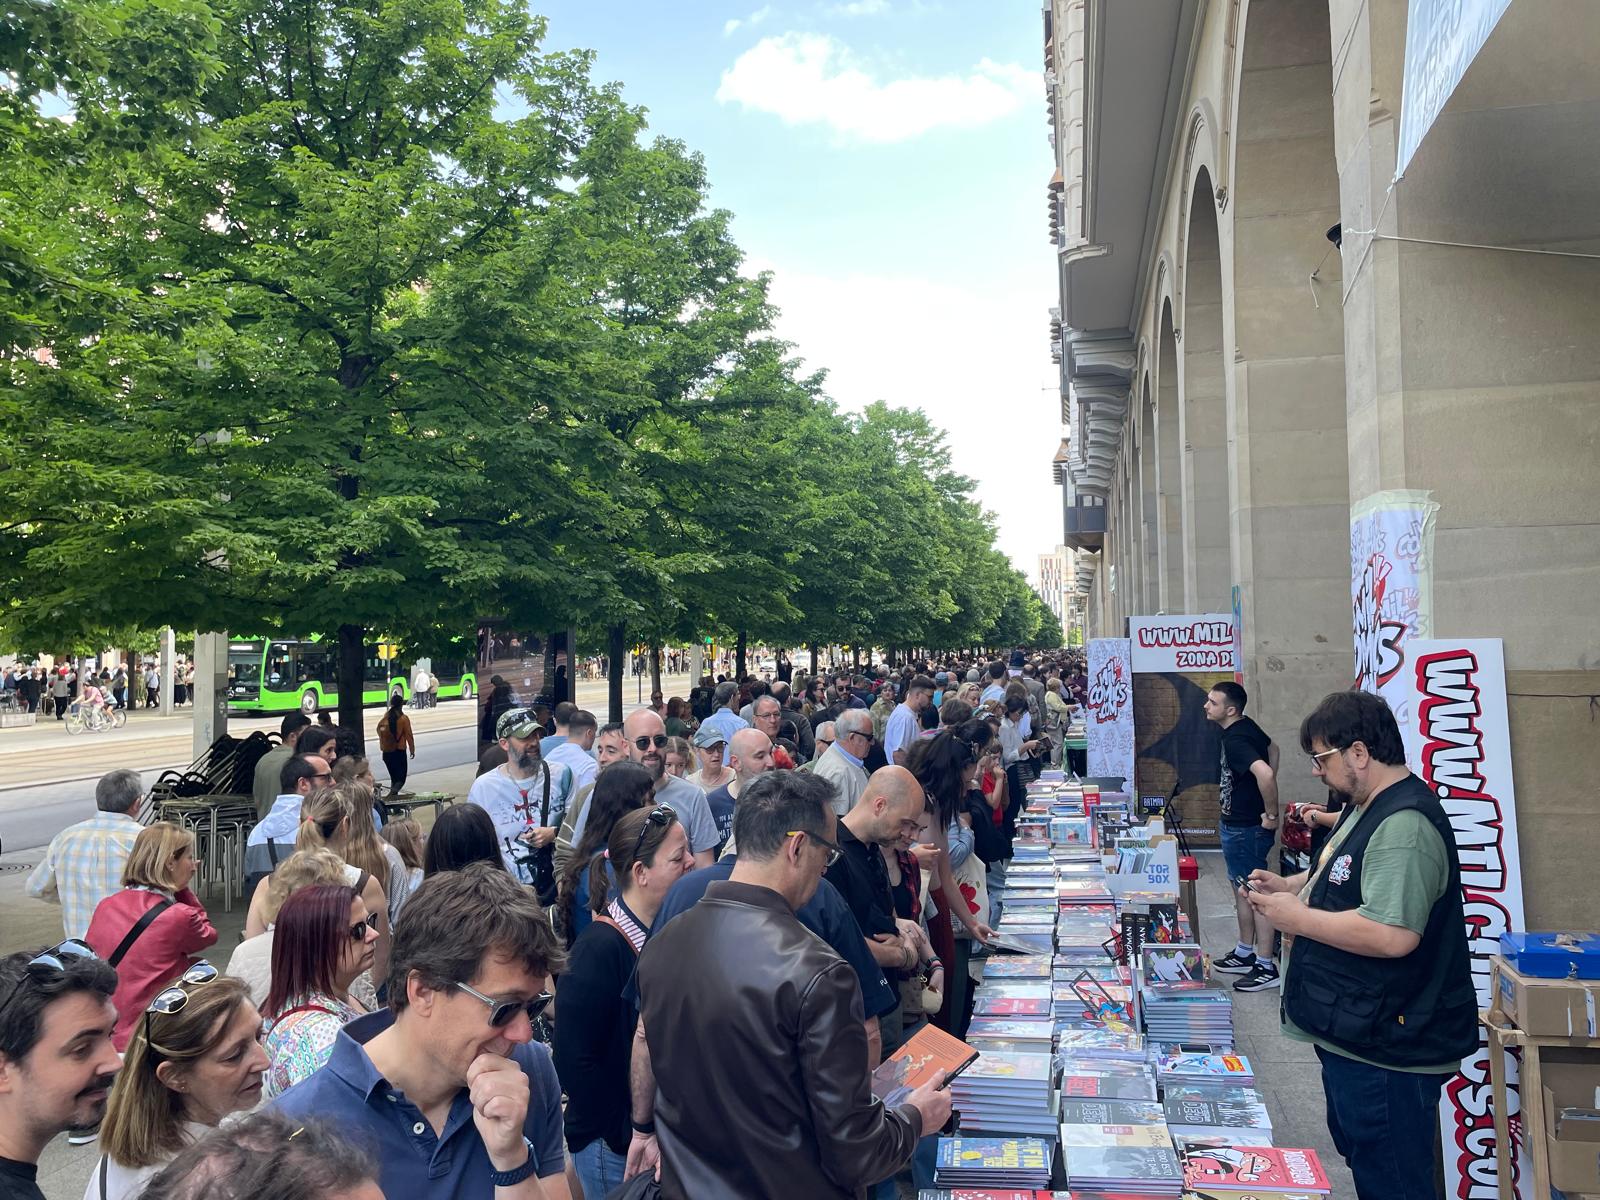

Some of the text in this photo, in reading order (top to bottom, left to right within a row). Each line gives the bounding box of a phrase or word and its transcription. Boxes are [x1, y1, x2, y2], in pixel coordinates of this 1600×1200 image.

[1138, 622, 1234, 648] WWW.MIL
[1176, 651, 1217, 668] ZONA
[1143, 797, 1164, 807] BATMAN
